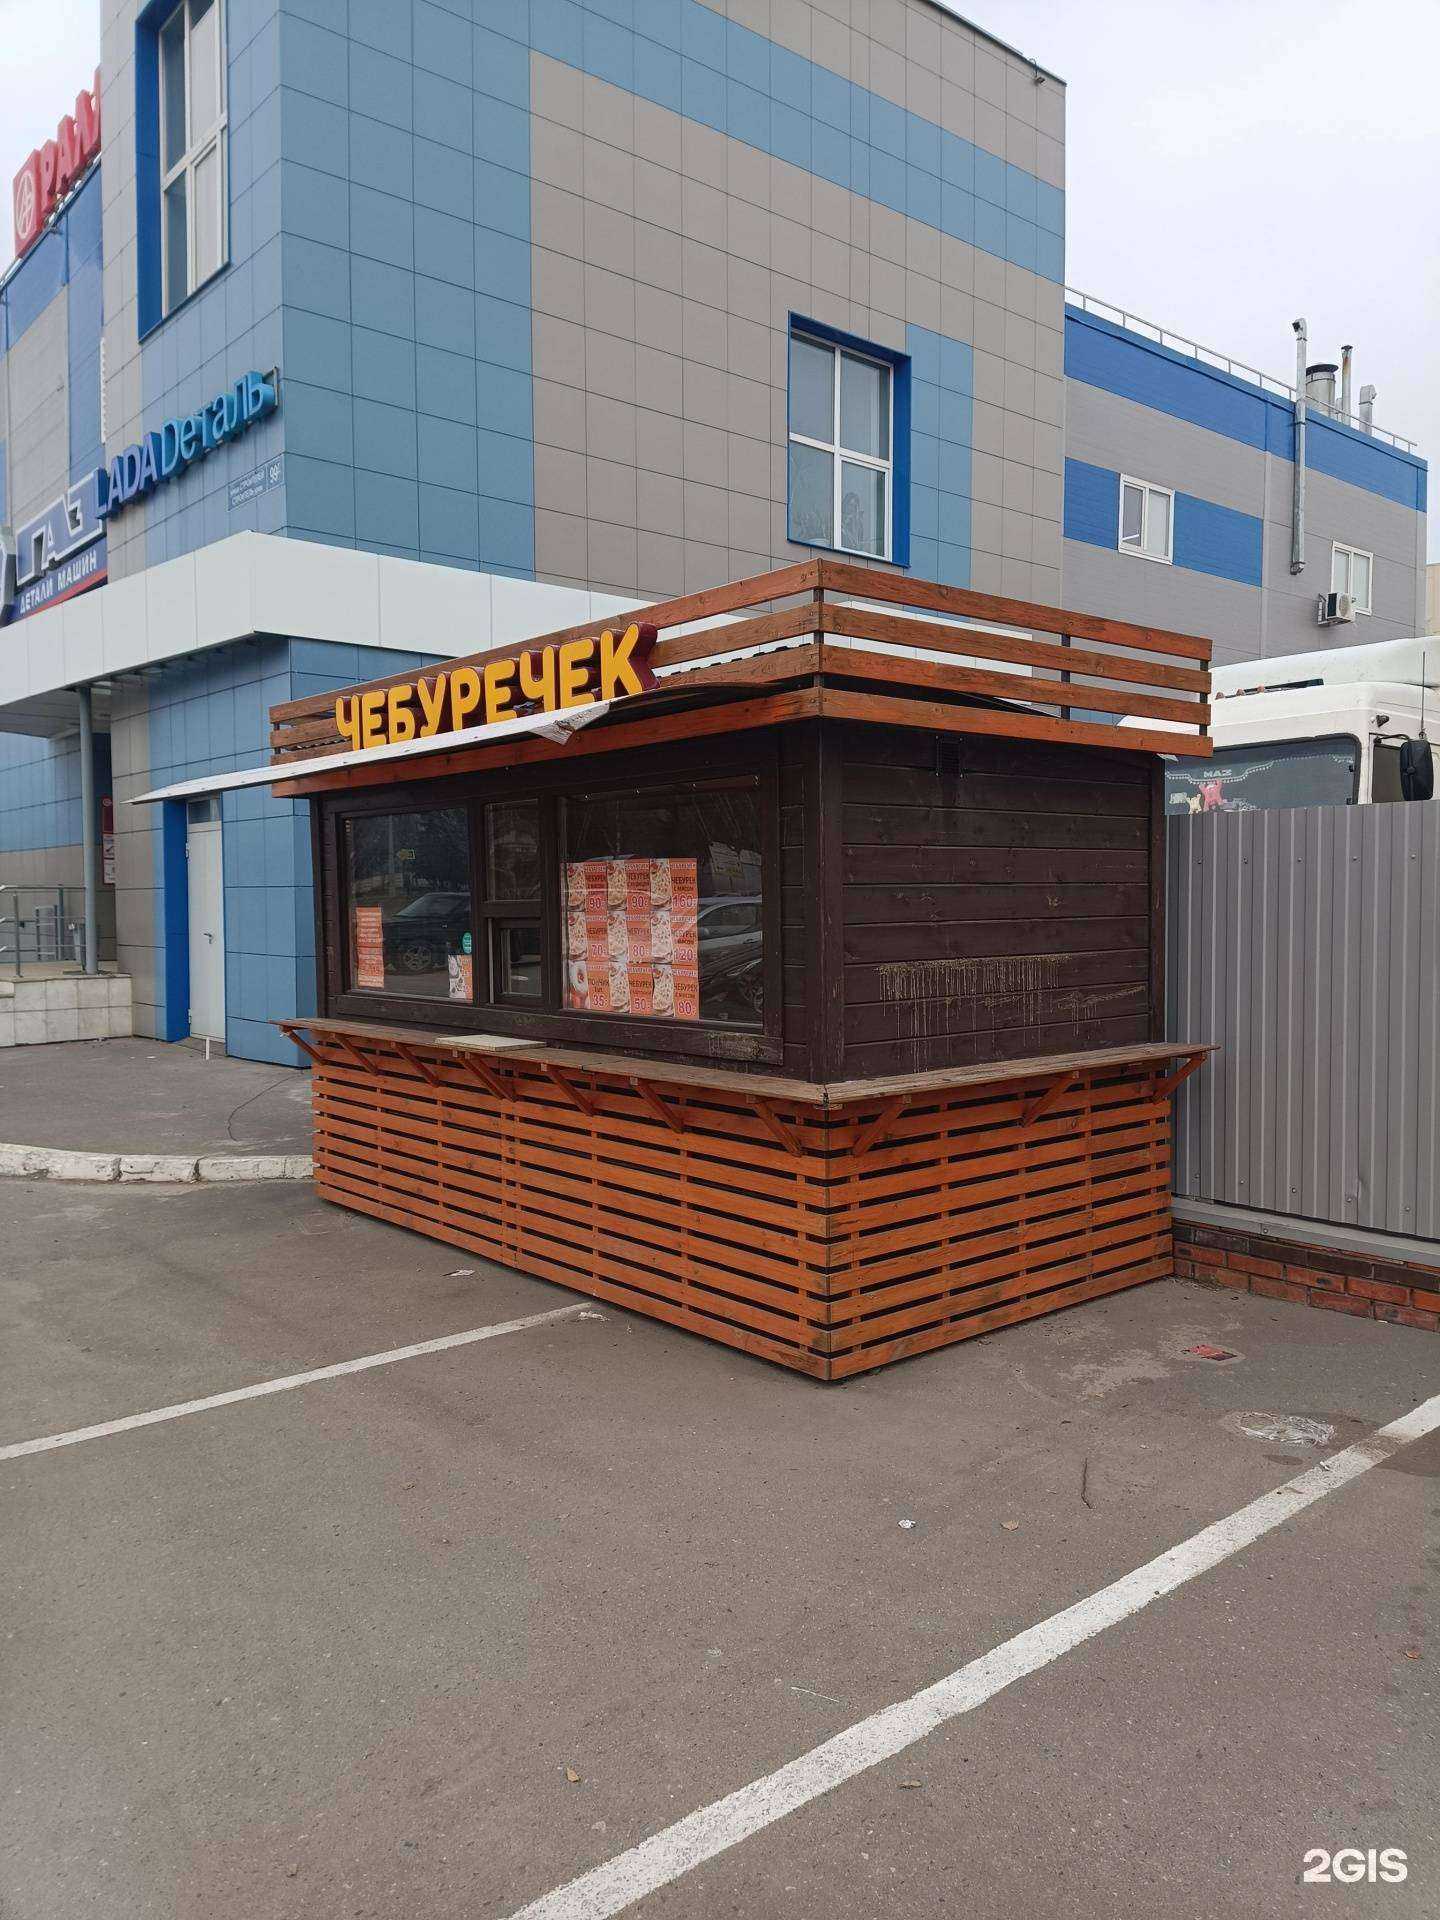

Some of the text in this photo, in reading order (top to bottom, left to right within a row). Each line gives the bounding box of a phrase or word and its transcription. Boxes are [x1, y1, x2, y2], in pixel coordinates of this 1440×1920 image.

[96, 432, 158, 517] LADA
[19, 549, 97, 614] ДЕТАЛИ МАШИН
[335, 622, 652, 751] ЧЕБУРЕЧЕК
